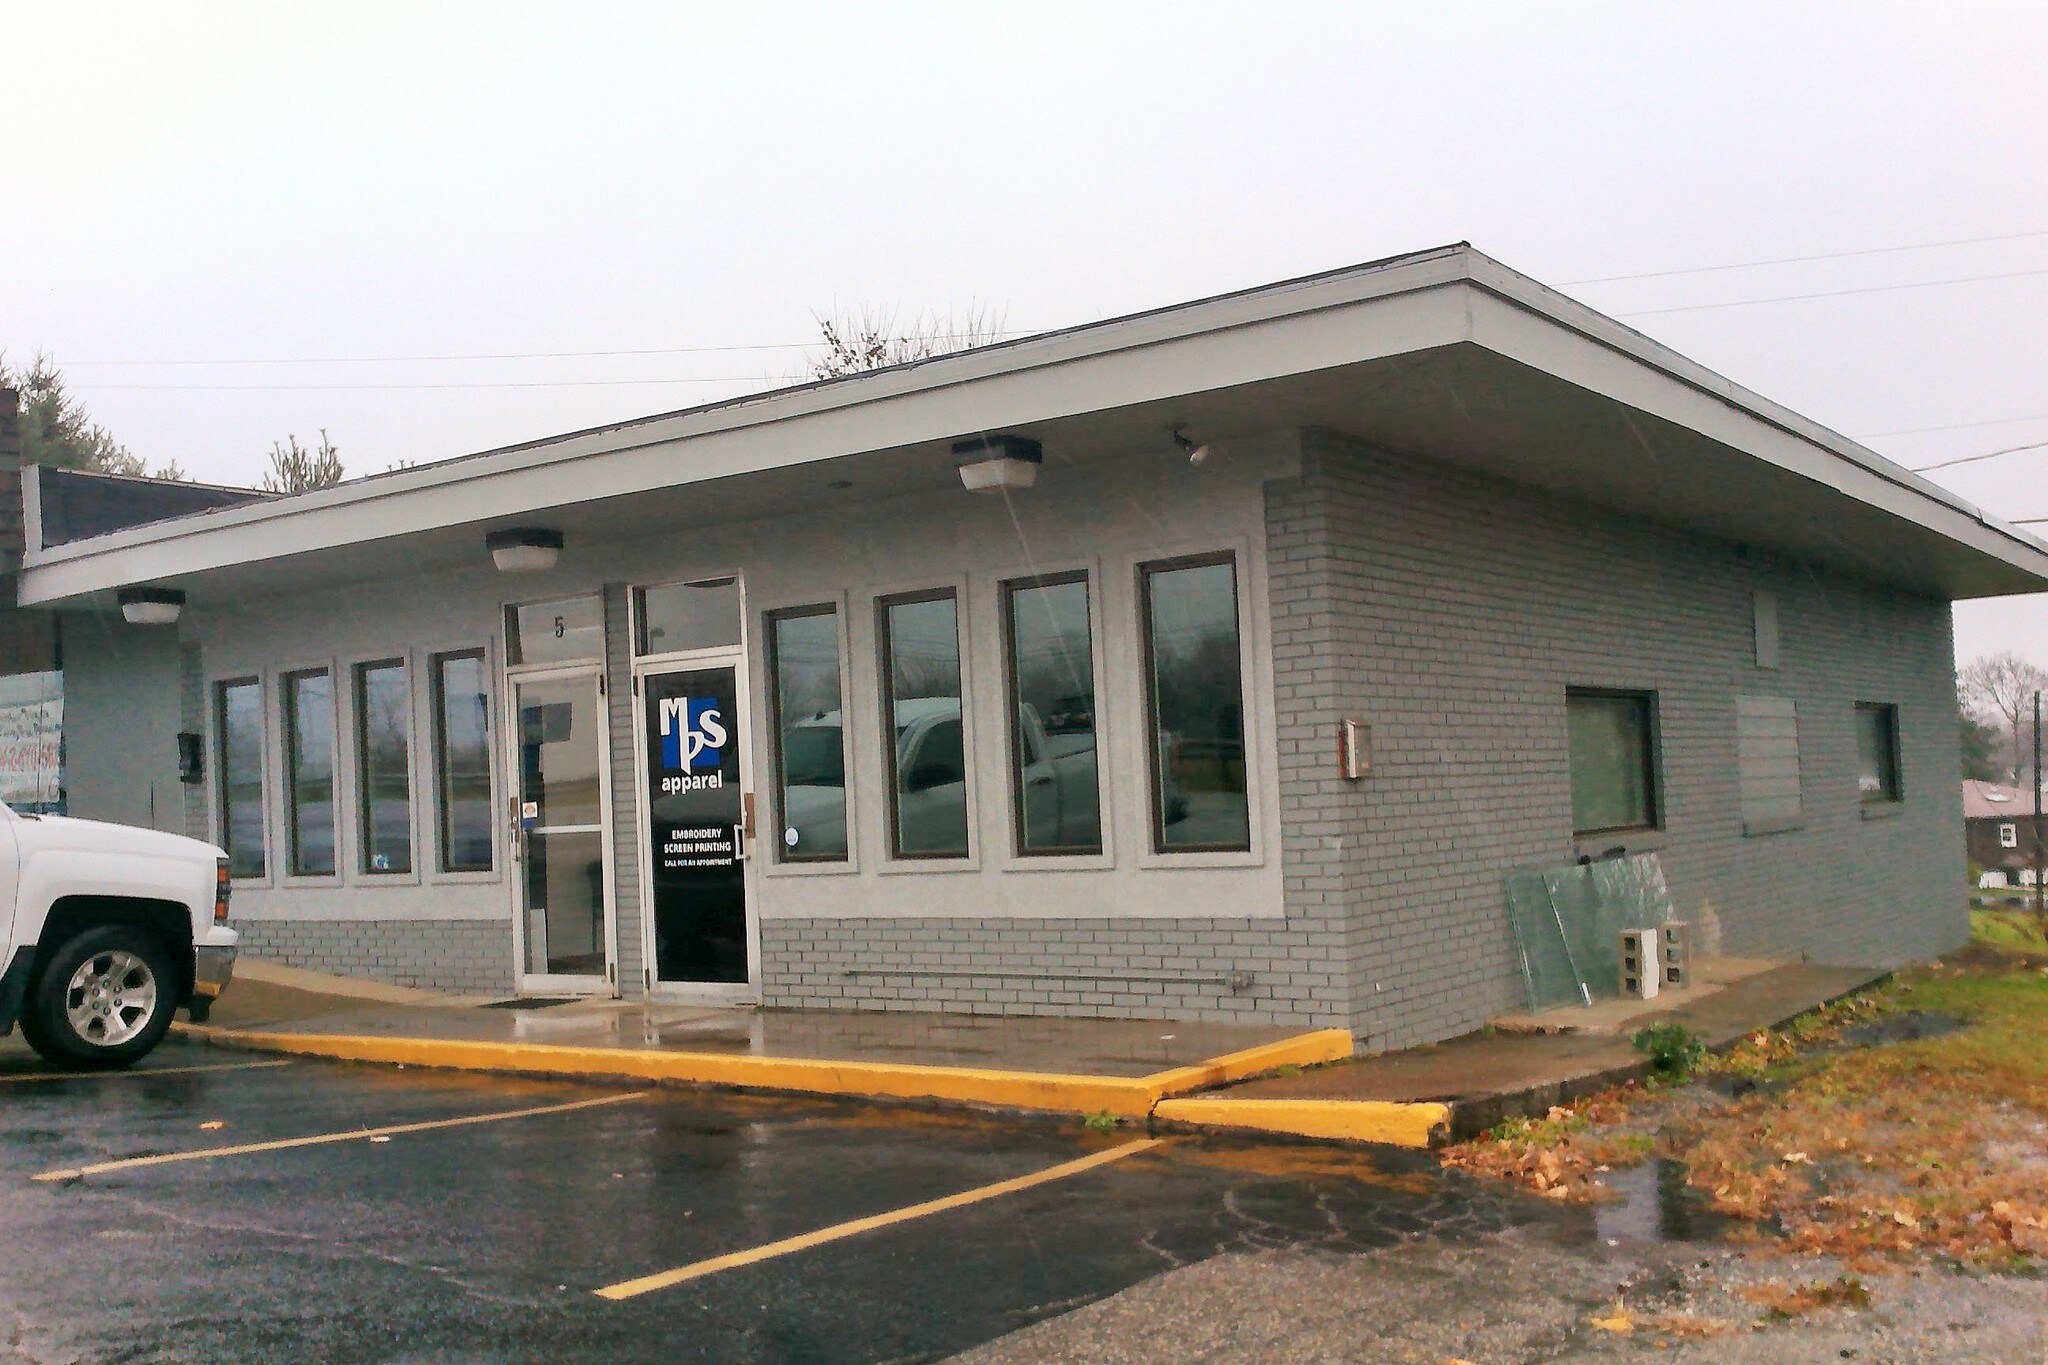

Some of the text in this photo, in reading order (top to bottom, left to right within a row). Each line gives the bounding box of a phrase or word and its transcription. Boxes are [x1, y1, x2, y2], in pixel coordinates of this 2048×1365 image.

[554, 615, 564, 638] 5
[662, 770, 722, 794] apparel
[671, 828, 722, 839] EMBROIDERY
[664, 842, 731, 853] SCREEN PRINTING
